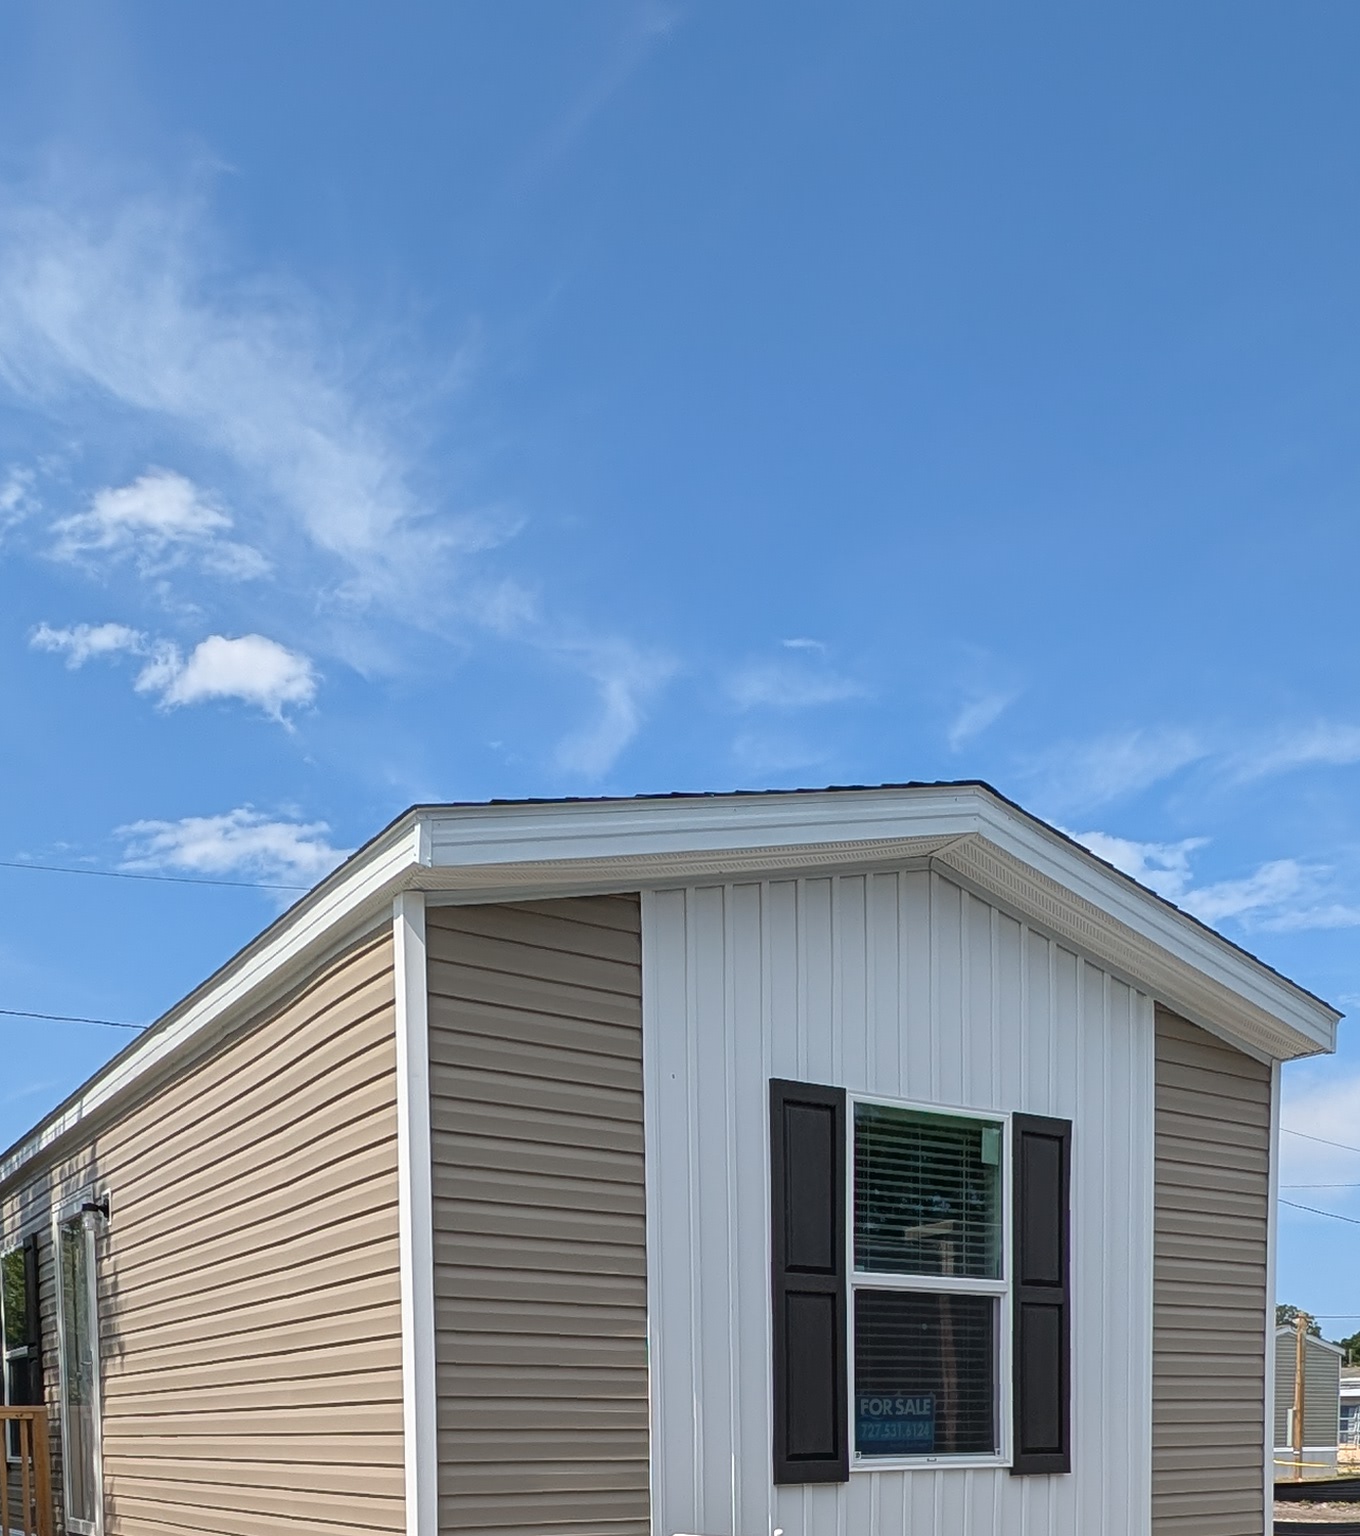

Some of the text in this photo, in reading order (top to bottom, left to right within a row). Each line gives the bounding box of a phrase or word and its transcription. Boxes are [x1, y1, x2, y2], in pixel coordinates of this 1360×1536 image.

[860, 1398, 931, 1415] FOR SALE
[861, 1423, 930, 1438] 727.531.6124
